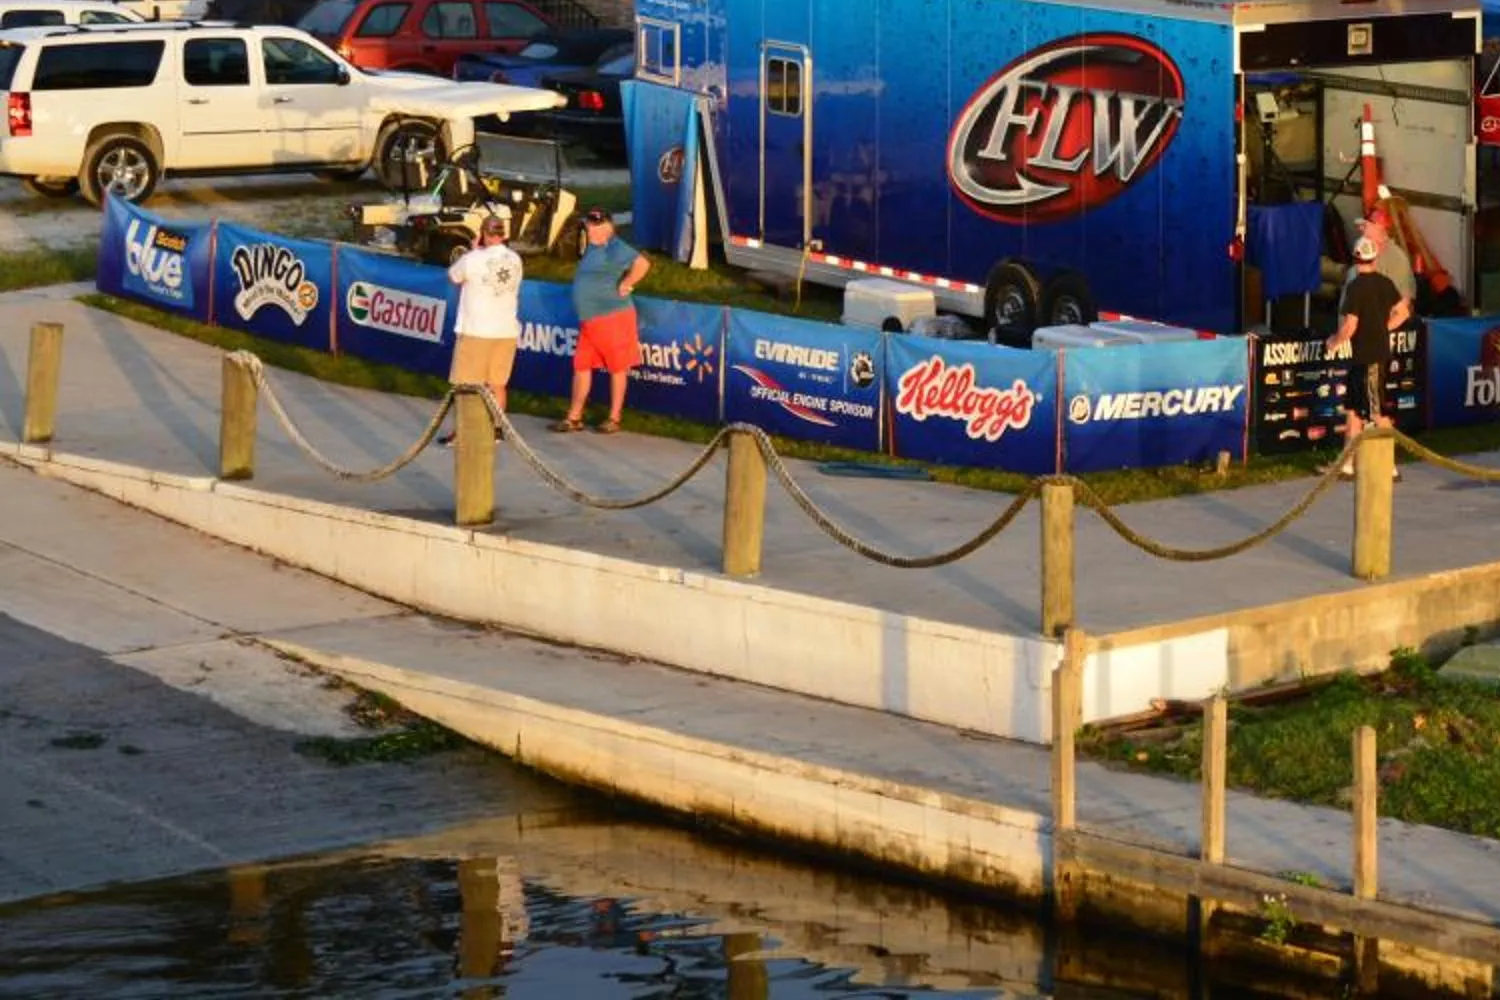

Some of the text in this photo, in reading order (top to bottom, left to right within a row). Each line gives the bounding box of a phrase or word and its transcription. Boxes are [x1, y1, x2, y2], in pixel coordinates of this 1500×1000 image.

[975, 72, 1184, 183] FLW
[125, 218, 184, 288] blue
[233, 244, 304, 291] DINGO
[370, 290, 438, 335] Castrol
[639, 340, 682, 371] mart
[755, 338, 839, 371] EVINRUDE
[1263, 339, 1324, 367] ASSOCIATE
[750, 385, 874, 419] OFFICIAL ENGINE SPONSOR
[898, 357, 1033, 438] Kellogg's
[1093, 384, 1244, 421] MERCURY
